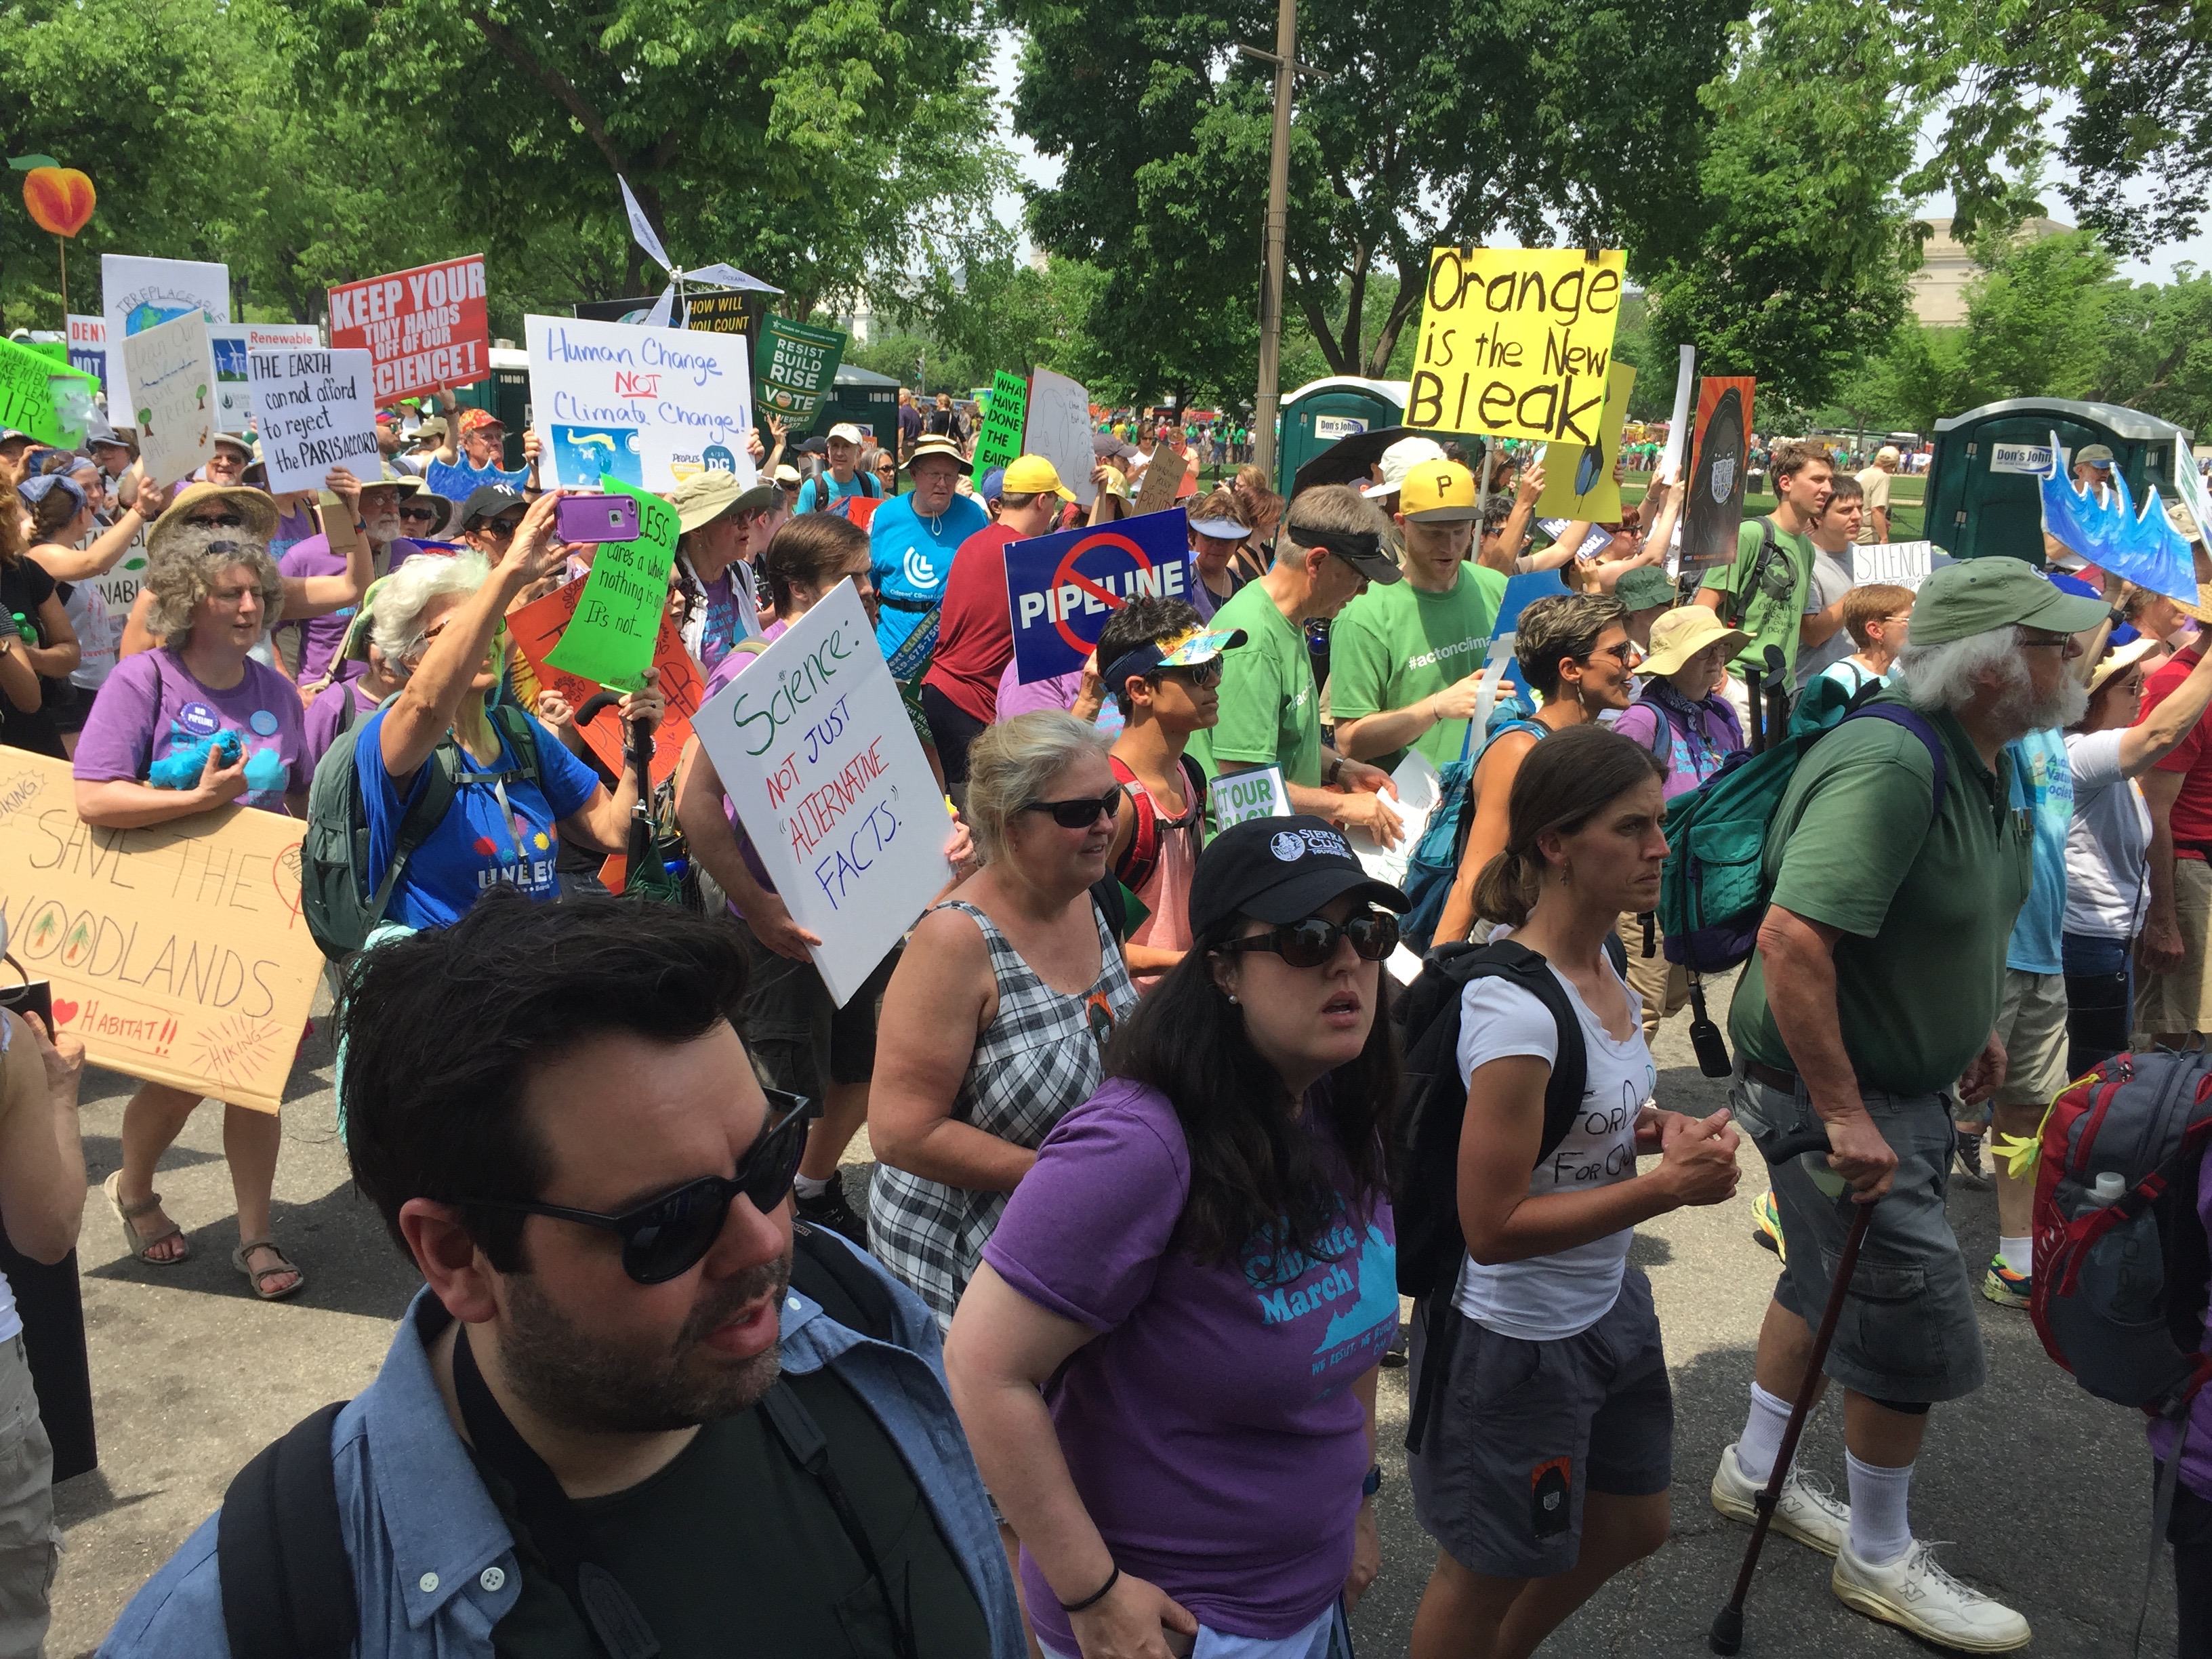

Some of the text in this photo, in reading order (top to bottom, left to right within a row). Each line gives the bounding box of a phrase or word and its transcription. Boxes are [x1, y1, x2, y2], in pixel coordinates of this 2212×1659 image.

[331, 262, 486, 331] KEEP YOUR
[1429, 251, 1619, 327] Orange
[690, 297, 743, 314] HOW WILL
[250, 331, 313, 344] Renewable
[363, 303, 460, 346] TINY HANDS
[690, 316, 750, 333] YOU COUNT
[375, 326, 451, 361] OFF OF OUR
[548, 327, 722, 386] Human Change
[777, 338, 825, 359] RESIST
[1424, 321, 1609, 377] is the New
[251, 352, 331, 380] THE EARTH
[773, 351, 822, 372] BUILD
[316, 375, 357, 402] afford
[615, 371, 662, 394] NOT
[769, 363, 819, 390] RISE
[17, 381, 52, 404] CLEAN
[991, 393, 1020, 415] HAVE
[554, 391, 745, 444] Climate Change!
[987, 409, 1021, 431] DONE
[1406, 370, 1602, 445] Bleak
[264, 405, 333, 440] to reject
[1321, 420, 1361, 432] Don's Johns
[275, 431, 378, 473] the PARIS ACCORD
[987, 429, 1009, 447] THE
[708, 457, 730, 471] DC
[1996, 449, 2052, 463] Don's John
[1436, 474, 1452, 498] P
[638, 556, 644, 571] a
[1857, 541, 1929, 580] SILENCE
[599, 569, 644, 610] nothing
[646, 584, 653, 605] is
[1019, 560, 1184, 630] PIPELINE
[583, 599, 609, 628] It's
[902, 611, 939, 655] CLIMATE
[734, 619, 860, 756] Science:
[188, 714, 214, 727] PIPELINE
[766, 693, 850, 809] NOT JUST
[1231, 779, 1273, 809] OUR
[1299, 829, 1346, 845] SIERRA
[1308, 838, 1346, 851] CLUB
[30, 809, 272, 912] SAVE THE
[209, 1031, 263, 1072] HIKING
[1257, 1263, 1355, 1326] March
